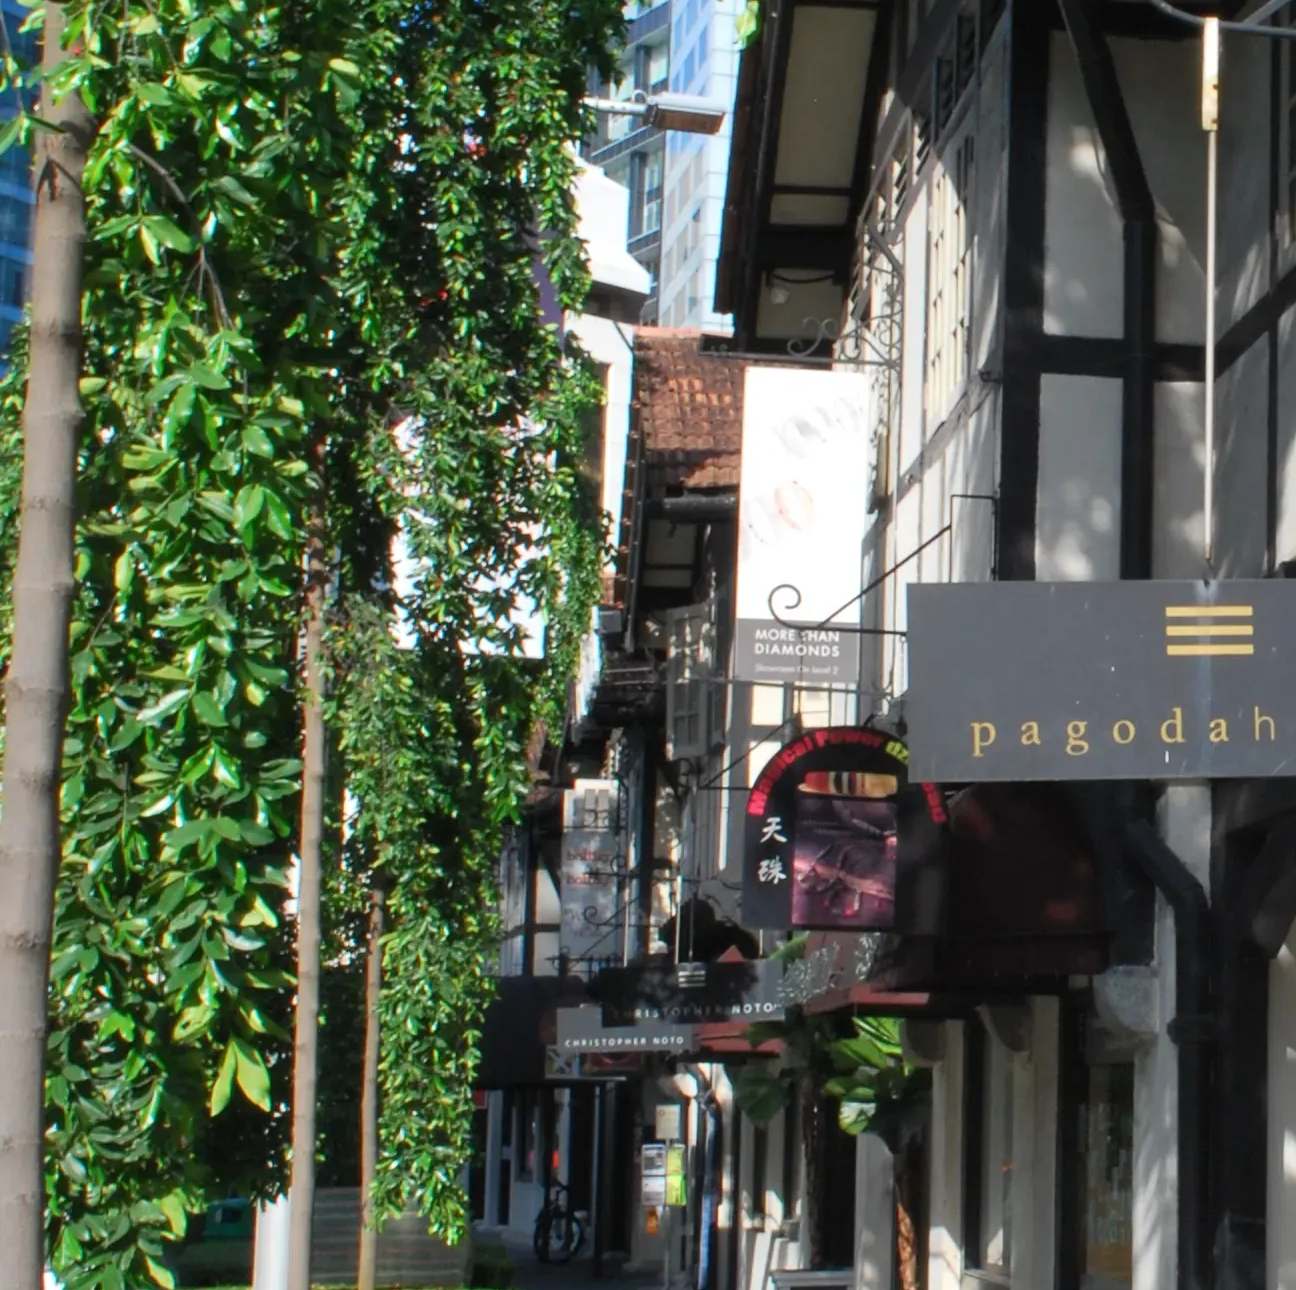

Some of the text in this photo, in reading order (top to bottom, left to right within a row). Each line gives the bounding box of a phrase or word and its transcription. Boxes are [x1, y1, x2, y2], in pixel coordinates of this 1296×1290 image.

[755, 629, 796, 641] MORE
[754, 644, 840, 657] DIAMONDS
[759, 816, 788, 884] 天珠
[732, 1002, 773, 1015] NOTO
[564, 1036, 685, 1048] CHRISTOPHER NOTO
